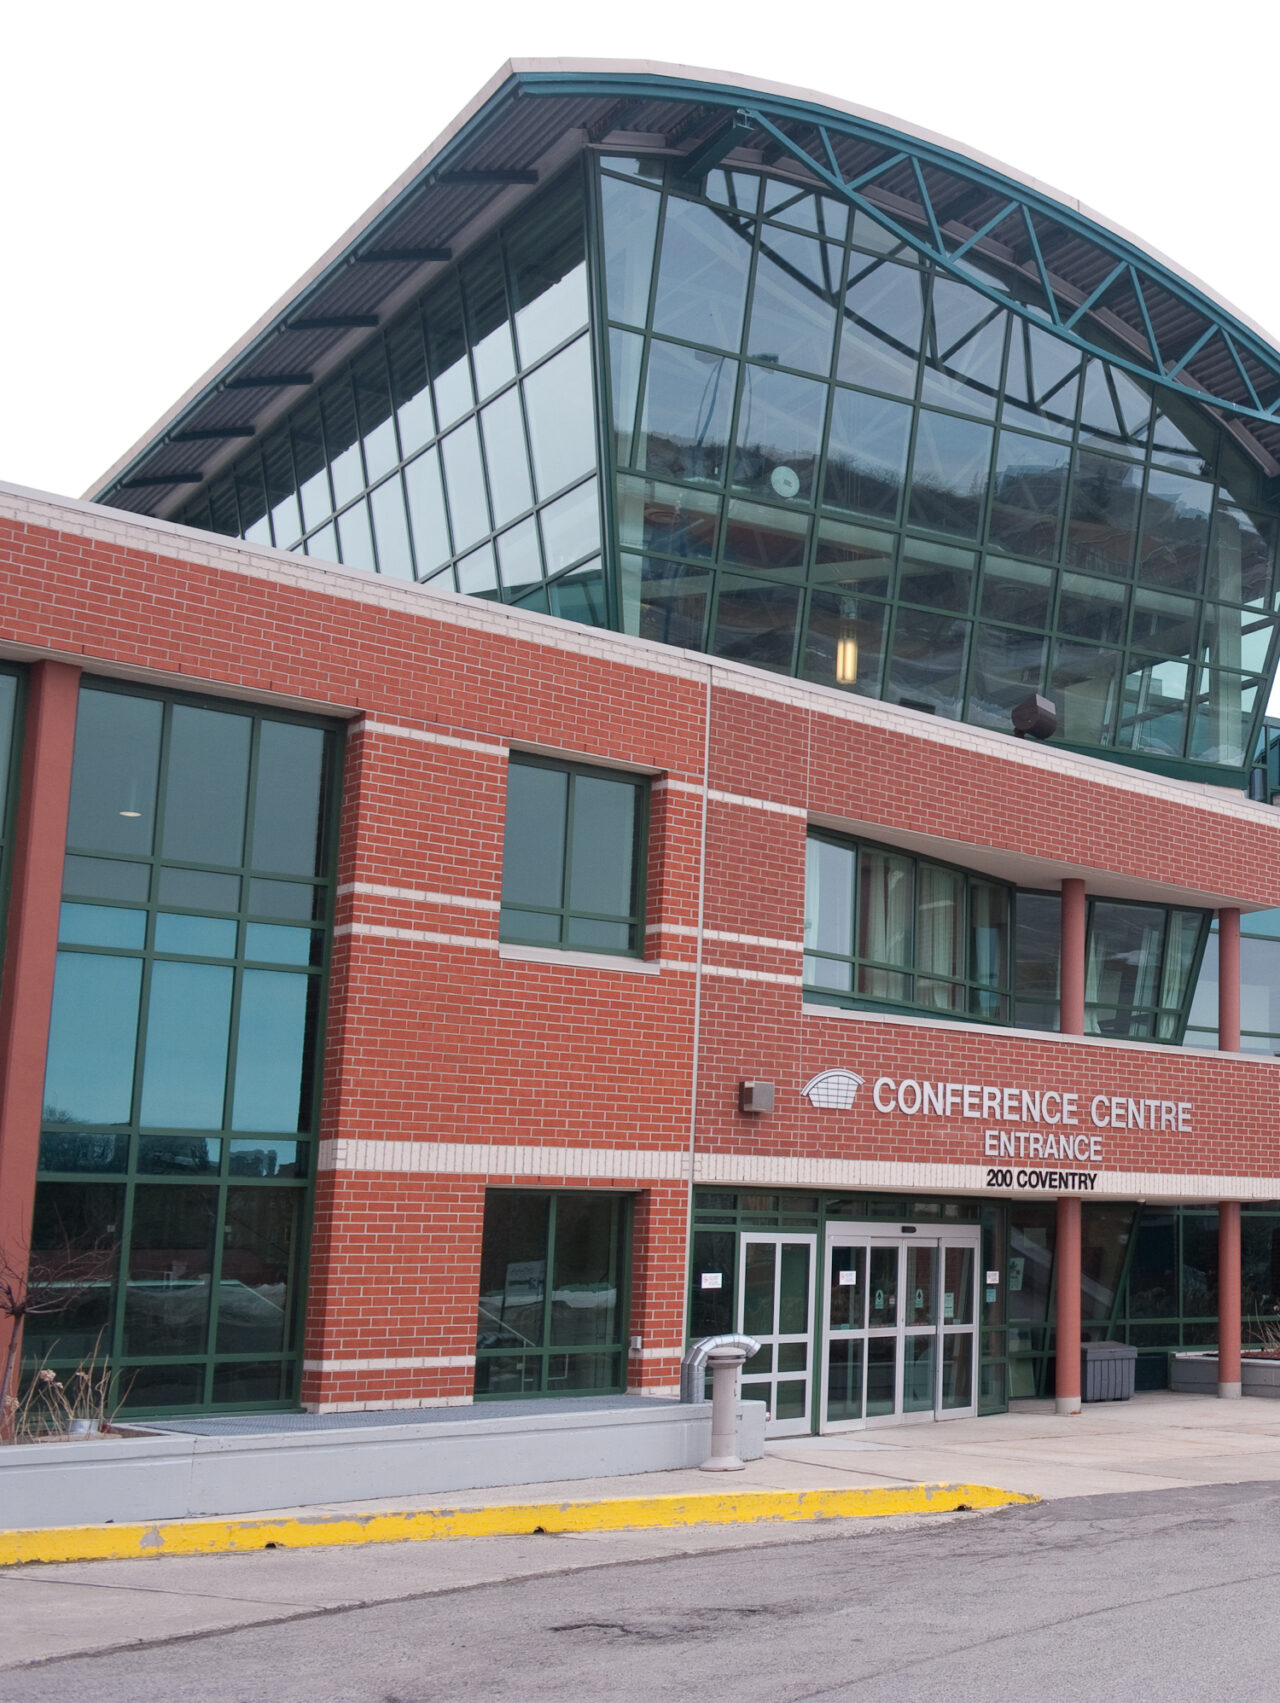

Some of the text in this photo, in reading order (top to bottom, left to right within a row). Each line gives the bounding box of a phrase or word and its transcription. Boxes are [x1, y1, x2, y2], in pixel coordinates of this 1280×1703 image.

[873, 1077, 1193, 1132] CONFERENCE CENTRE
[985, 1130, 1103, 1161] ENTRANCE
[987, 1169, 1098, 1190] 200 COVENTRY
